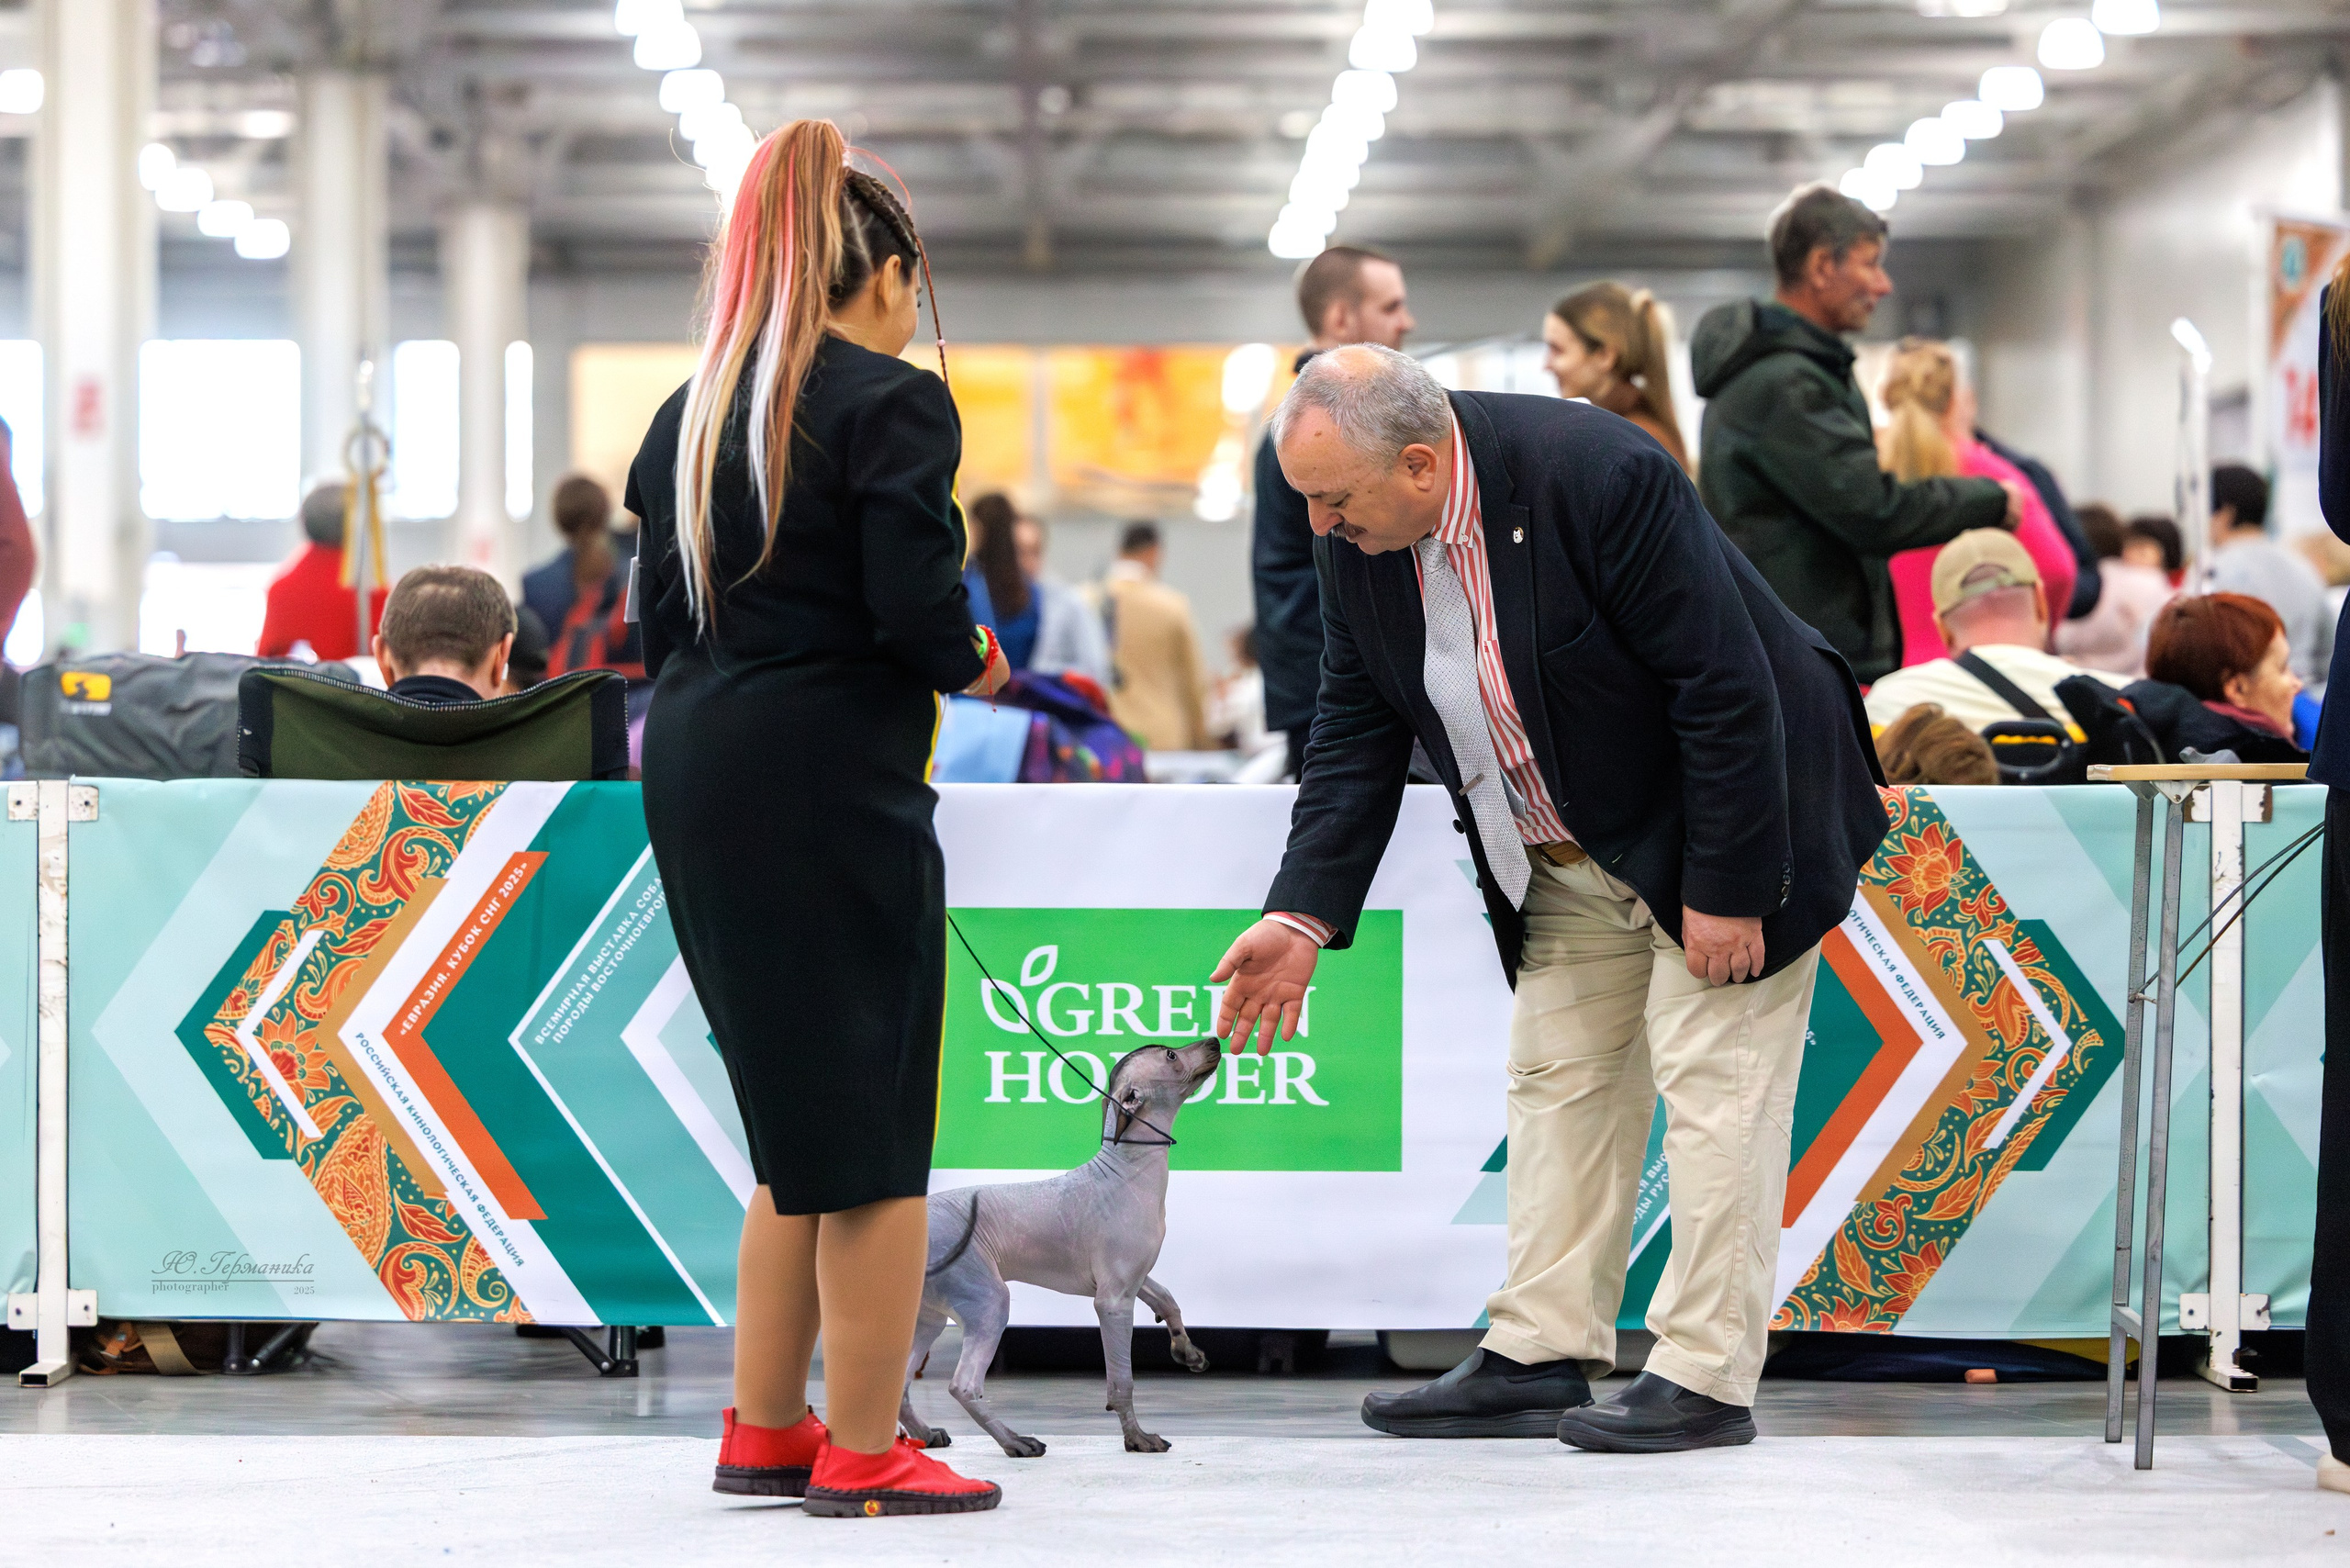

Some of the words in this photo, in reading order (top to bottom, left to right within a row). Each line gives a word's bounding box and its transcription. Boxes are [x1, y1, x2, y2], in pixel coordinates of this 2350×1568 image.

[400, 972, 451, 1036] «ЕВРАЗИЯ.
[446, 924, 482, 969] КУБОК
[479, 897, 501, 924] СНГ
[498, 862, 528, 898] 2025»
[534, 973, 591, 1045] ВСЕМИРНАЯ
[588, 911, 639, 974] ВЫСТАВКА
[636, 877, 662, 909] СОБА
[553, 991, 594, 1044] ПОРОДЫ
[1848, 909, 1897, 972] ОГИЧЕСКАЯ
[1895, 973, 1945, 1039] ФЕДЕРАЦИЯ
[355, 1032, 409, 1104] РОССИЙСКАЯ
[407, 1103, 479, 1203] КИНОЛОГИЧЕСКАЯ
[476, 1203, 524, 1267] ФЕДЕРАЦИЯ
[984, 1050, 1329, 1106] HOER
